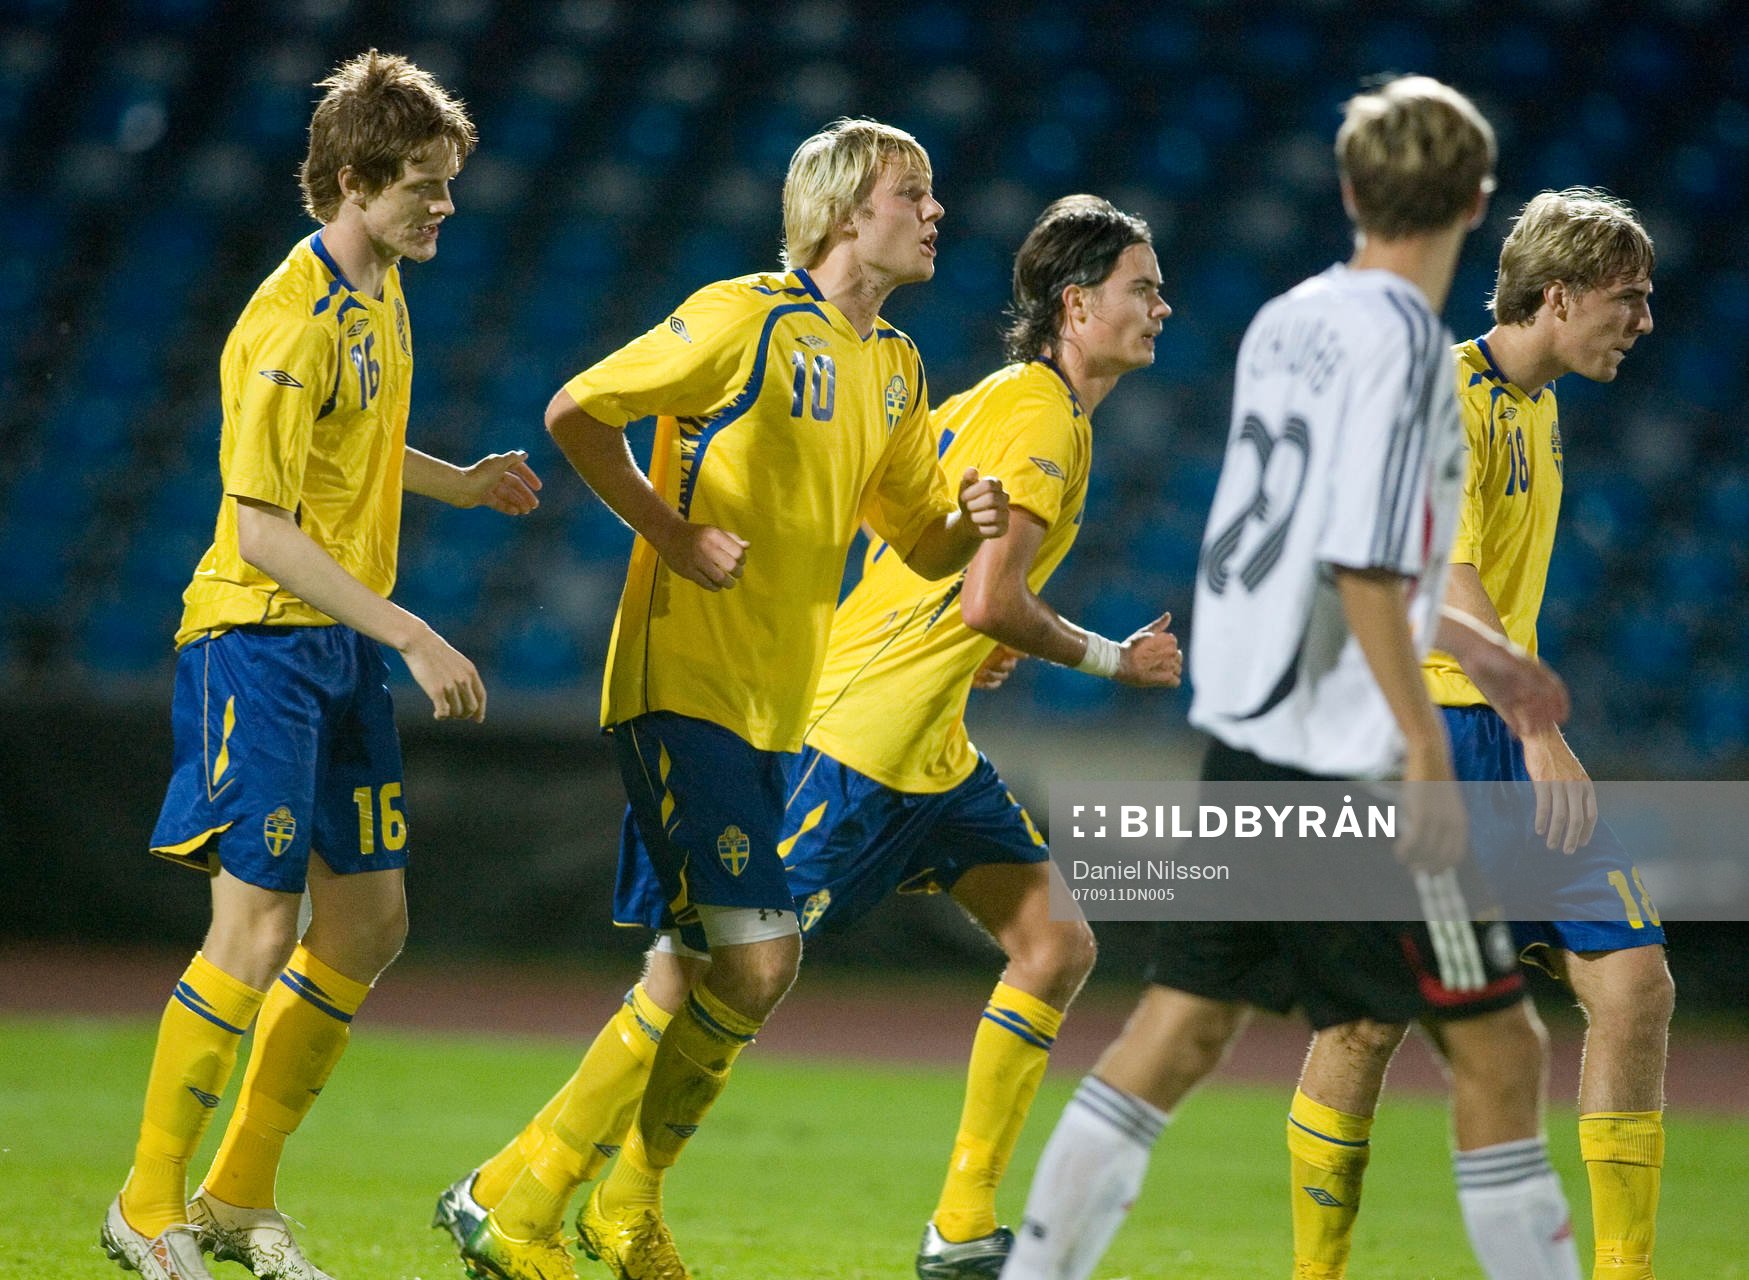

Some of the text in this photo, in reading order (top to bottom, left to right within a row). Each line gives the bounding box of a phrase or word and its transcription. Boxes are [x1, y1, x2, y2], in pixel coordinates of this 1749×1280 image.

[350, 333, 380, 411] 16
[791, 350, 836, 422] 10
[1505, 426, 1529, 496] 18
[353, 782, 408, 855] 16
